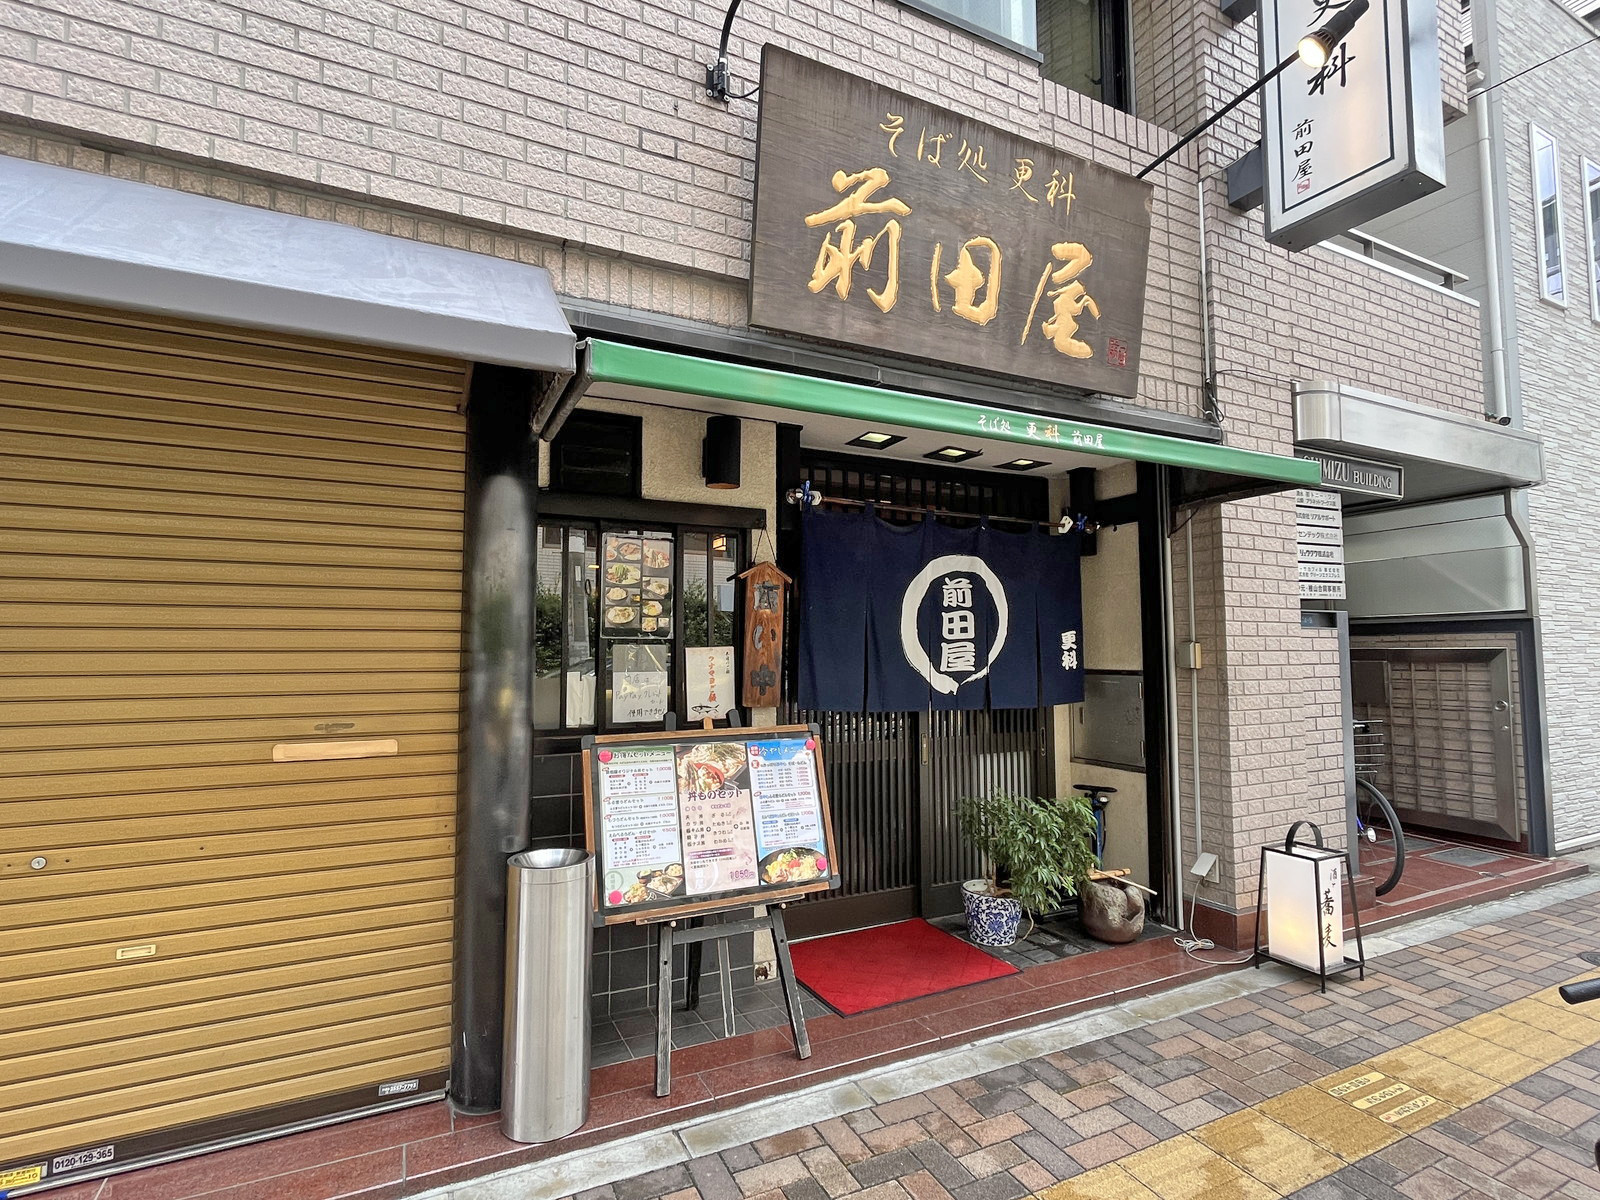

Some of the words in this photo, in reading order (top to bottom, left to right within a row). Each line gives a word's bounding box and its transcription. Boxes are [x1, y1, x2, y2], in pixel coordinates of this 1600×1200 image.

[879, 112, 989, 184] そば処
[1009, 158, 1077, 216] 更科
[1291, 118, 1316, 182] 前田屋
[805, 167, 1101, 360] 前田屋
[977, 415, 1013, 434] そば処
[1026, 422, 1060, 443] 更科
[1071, 430, 1105, 449] 前田屋
[1353, 470, 1392, 489] BUILDING
[940, 577, 976, 672] 前田屋
[1061, 630, 1078, 670] 更科
[687, 789, 743, 802] 丼ものセット
[54, 1148, 113, 1170] 0120-129-365
